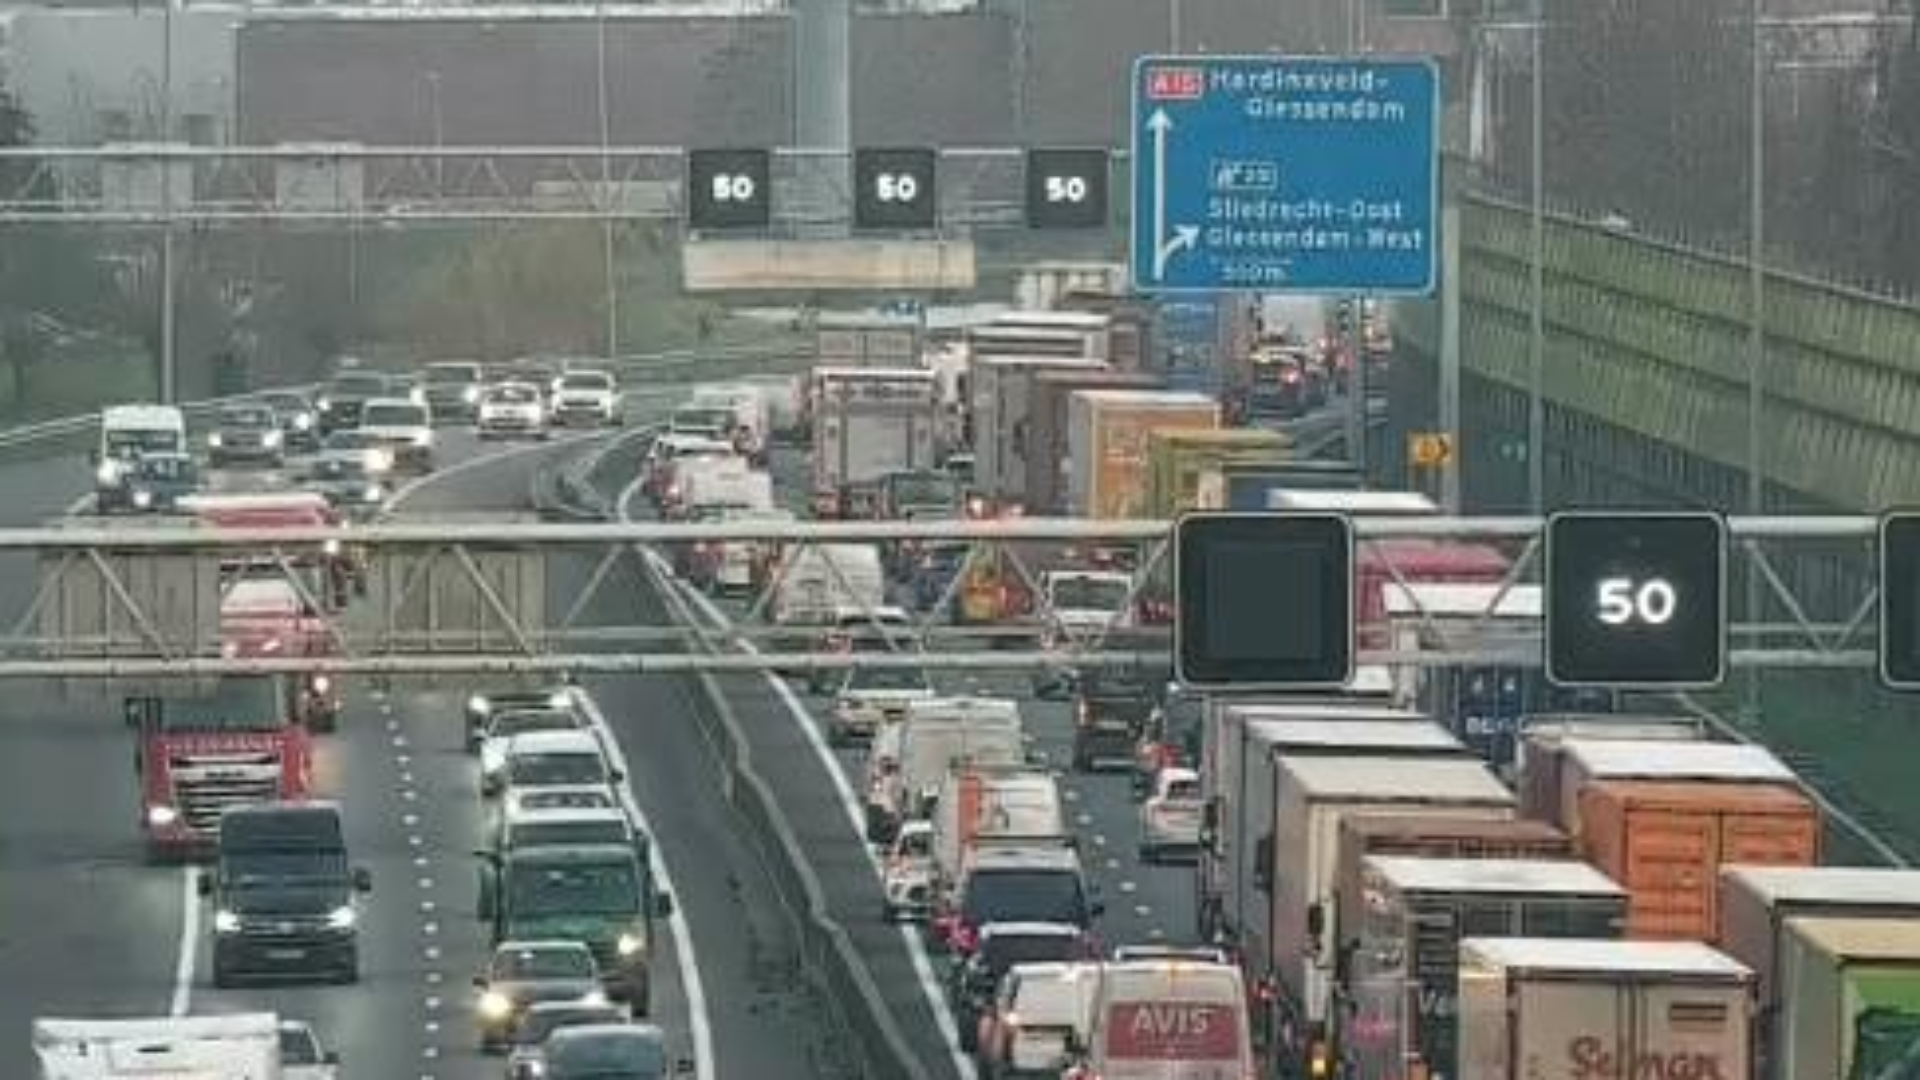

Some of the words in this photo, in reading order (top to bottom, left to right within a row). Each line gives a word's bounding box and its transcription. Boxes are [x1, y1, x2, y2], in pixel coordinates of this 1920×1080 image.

[712, 173, 754, 201] 50
[876, 173, 916, 201] 50
[1045, 176, 1086, 202] 50
[1597, 578, 1675, 623] 50
[1132, 1005, 1214, 1034] AVIS
